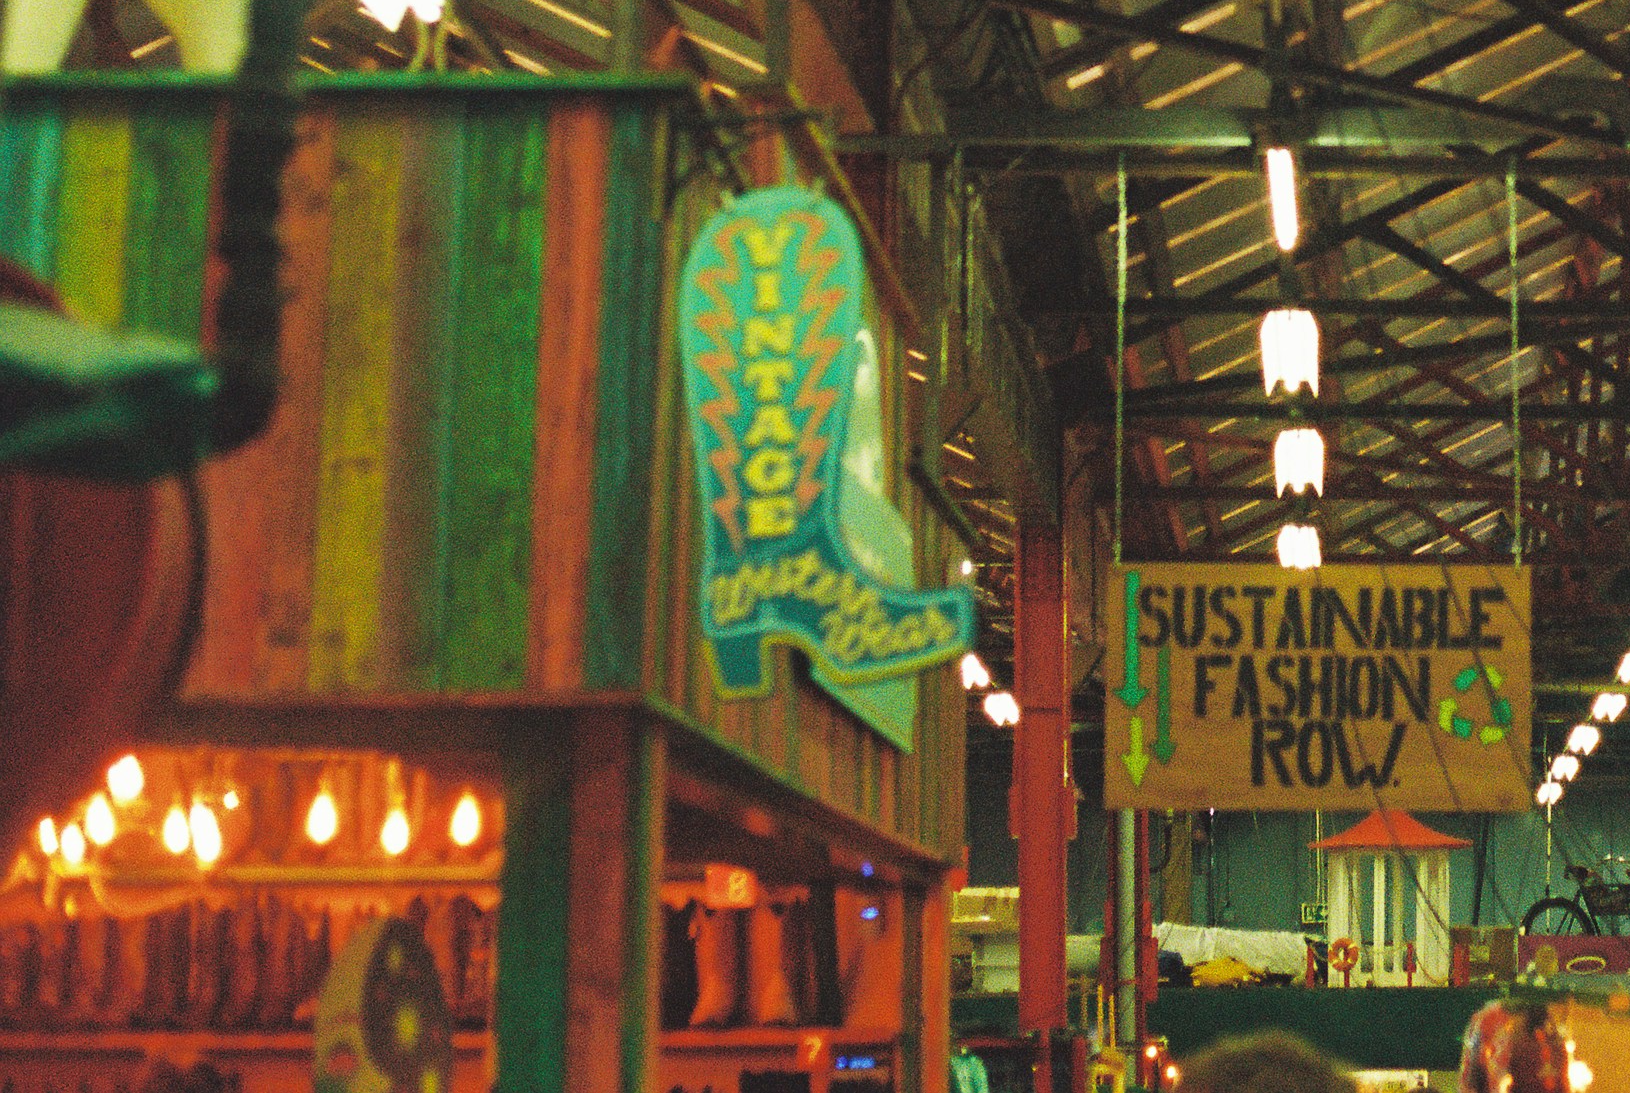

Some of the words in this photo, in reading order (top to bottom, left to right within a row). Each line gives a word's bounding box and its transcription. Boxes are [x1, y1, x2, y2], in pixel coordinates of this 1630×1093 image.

[743, 221, 797, 539] VINTAGE
[1137, 584, 1506, 650] SUSTAINABLE
[1193, 654, 1431, 724] FASHION
